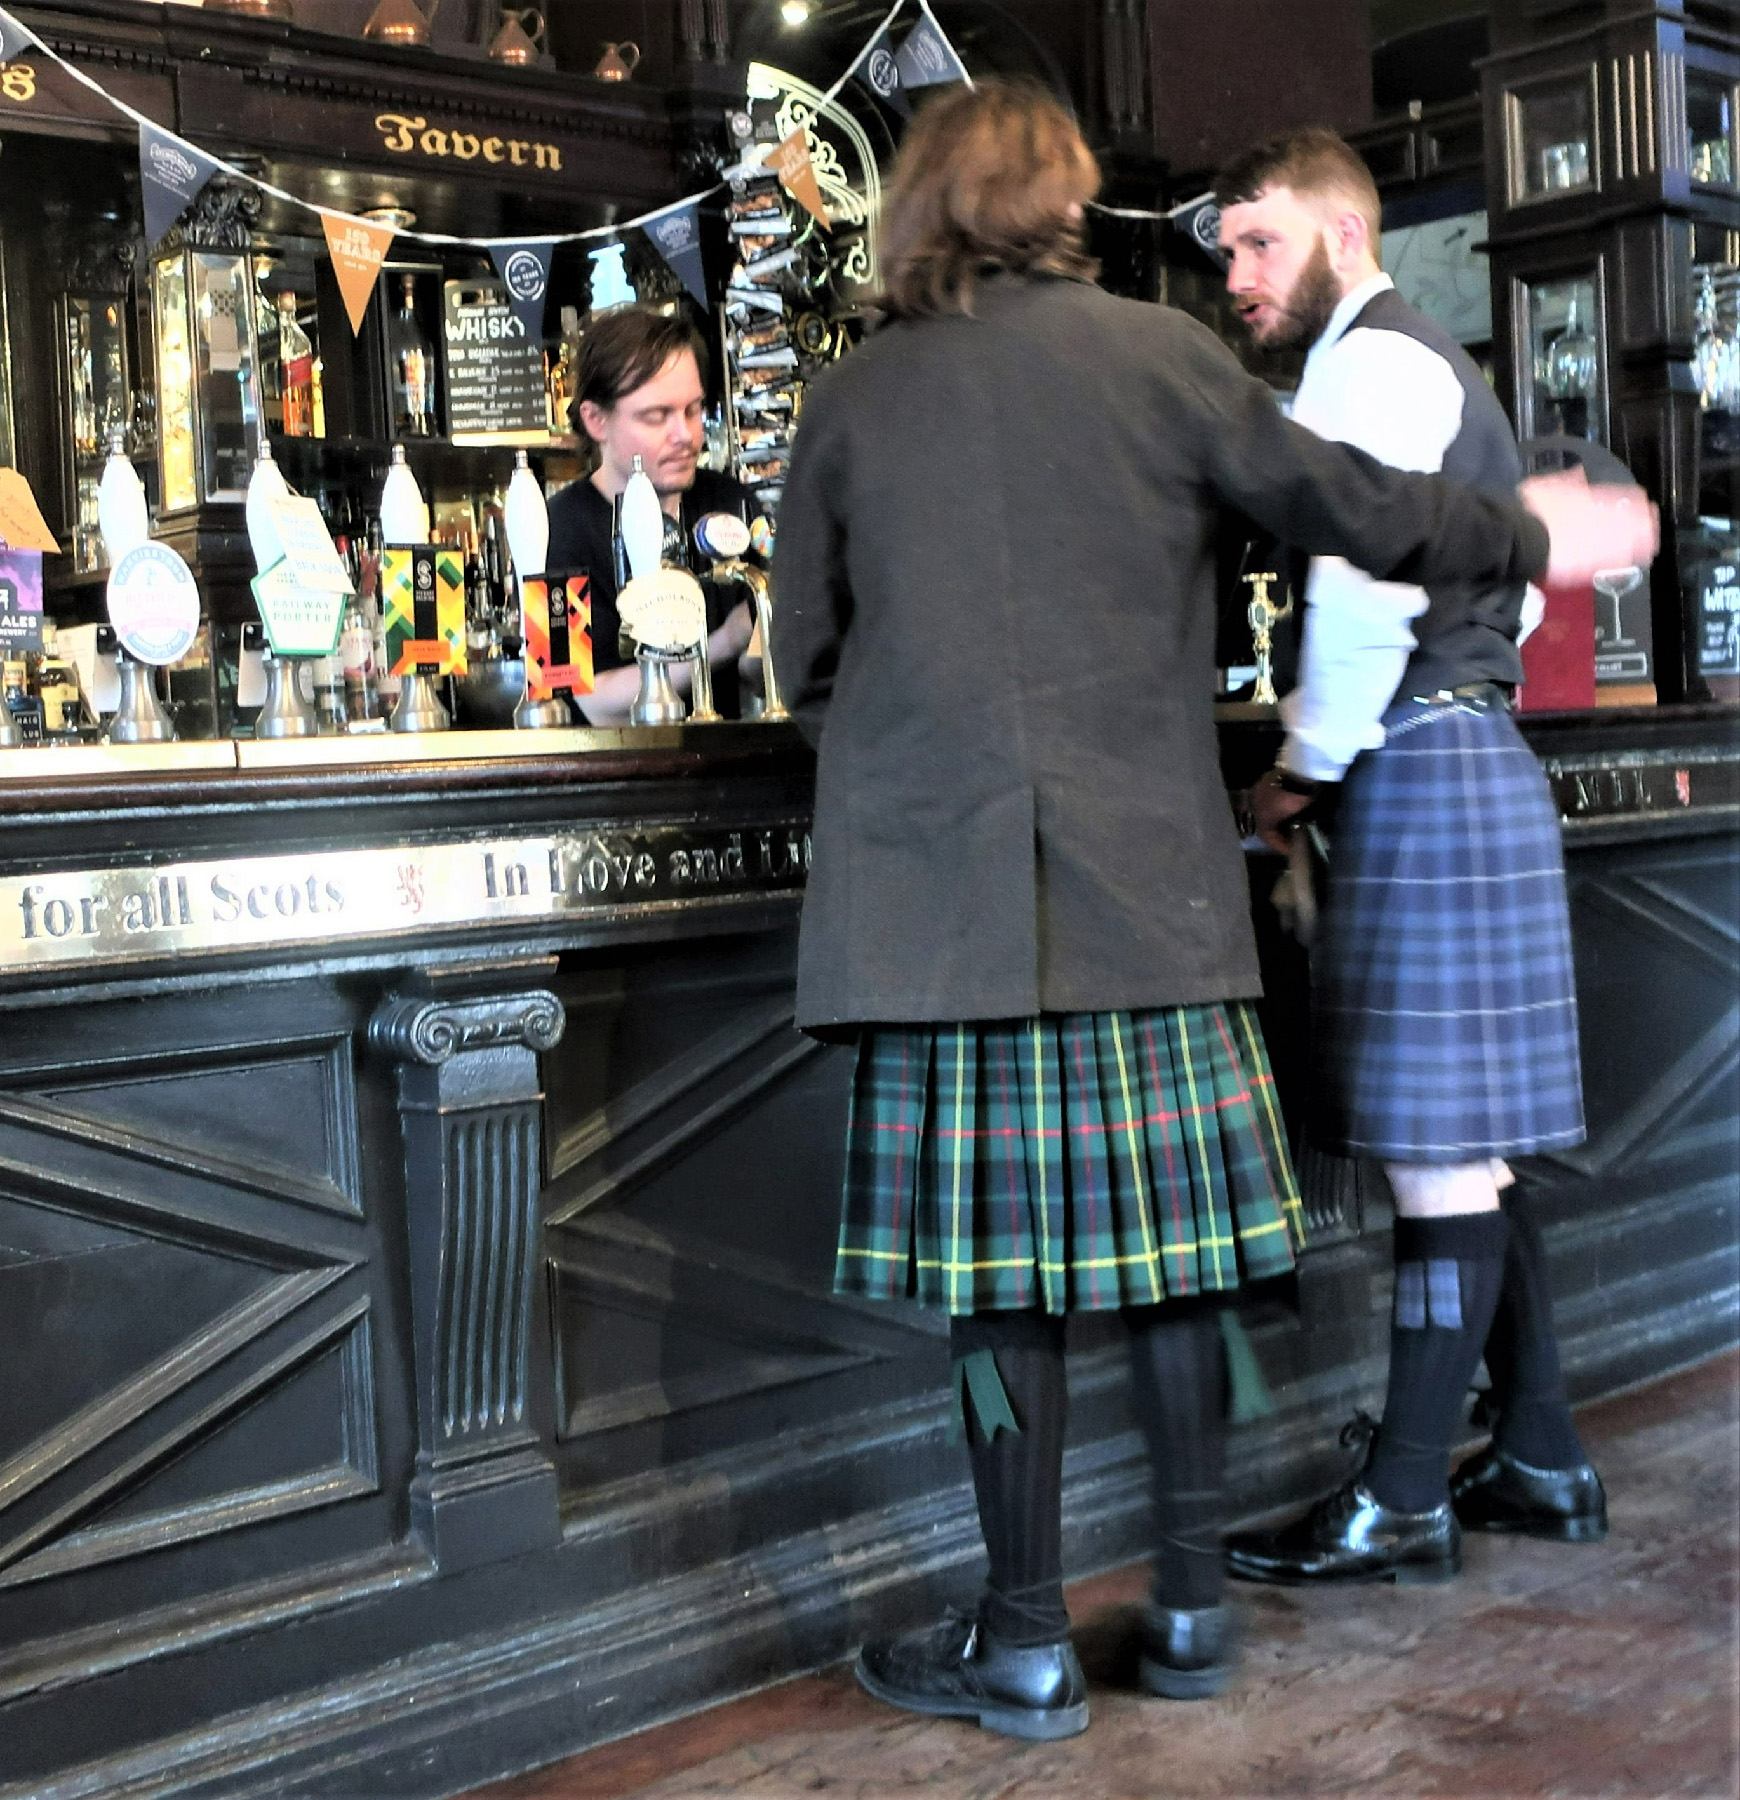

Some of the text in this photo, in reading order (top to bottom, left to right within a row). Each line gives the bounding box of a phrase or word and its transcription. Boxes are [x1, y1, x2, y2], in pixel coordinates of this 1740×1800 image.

[374, 113, 562, 171] Tavern
[331, 236, 381, 264] YEARS
[272, 598, 331, 610] RAILWAY
[272, 611, 332, 623] PORTER
[0, 628, 27, 636] REWERY
[23, 730, 39, 739] LUB
[481, 851, 530, 899] In
[547, 846, 657, 895] Love
[668, 833, 747, 884] and
[18, 872, 345, 939] for all Scots
